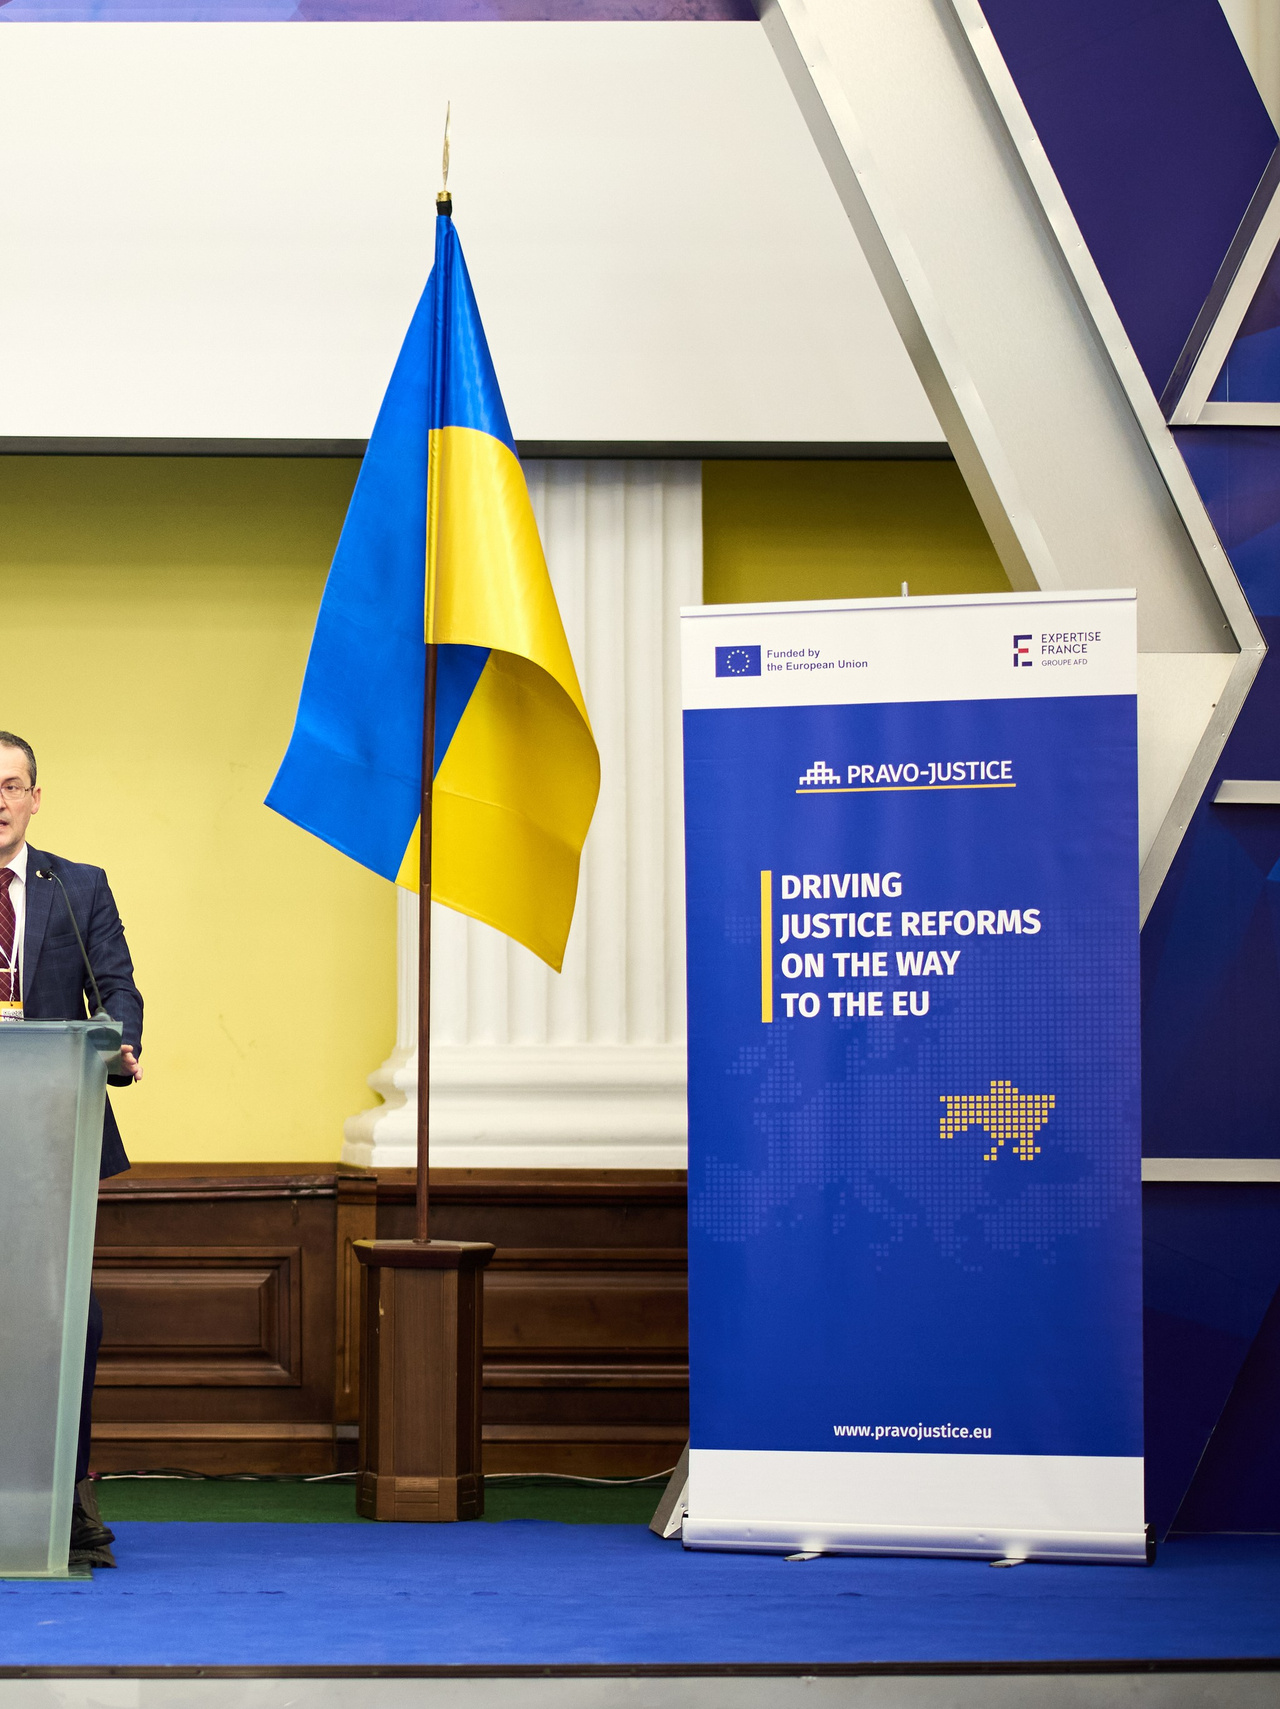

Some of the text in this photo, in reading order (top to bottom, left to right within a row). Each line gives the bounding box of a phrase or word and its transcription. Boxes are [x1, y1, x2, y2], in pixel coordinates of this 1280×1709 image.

[1041, 631, 1101, 643] EXPERTISE
[766, 648, 821, 659] Funded by
[1041, 643, 1088, 655] FRANCE
[766, 660, 868, 671] the European Union
[1041, 658, 1088, 666] GROUPE AFD
[847, 760, 1013, 785] PRAVO-JUSTICE
[781, 871, 903, 900] DRIVING
[779, 908, 1042, 945] JUSTICE REFORMS
[781, 950, 961, 979] ON THE WAY
[780, 990, 930, 1018] TO THE EU
[833, 1422, 992, 1441] www.pravojustice.eu
